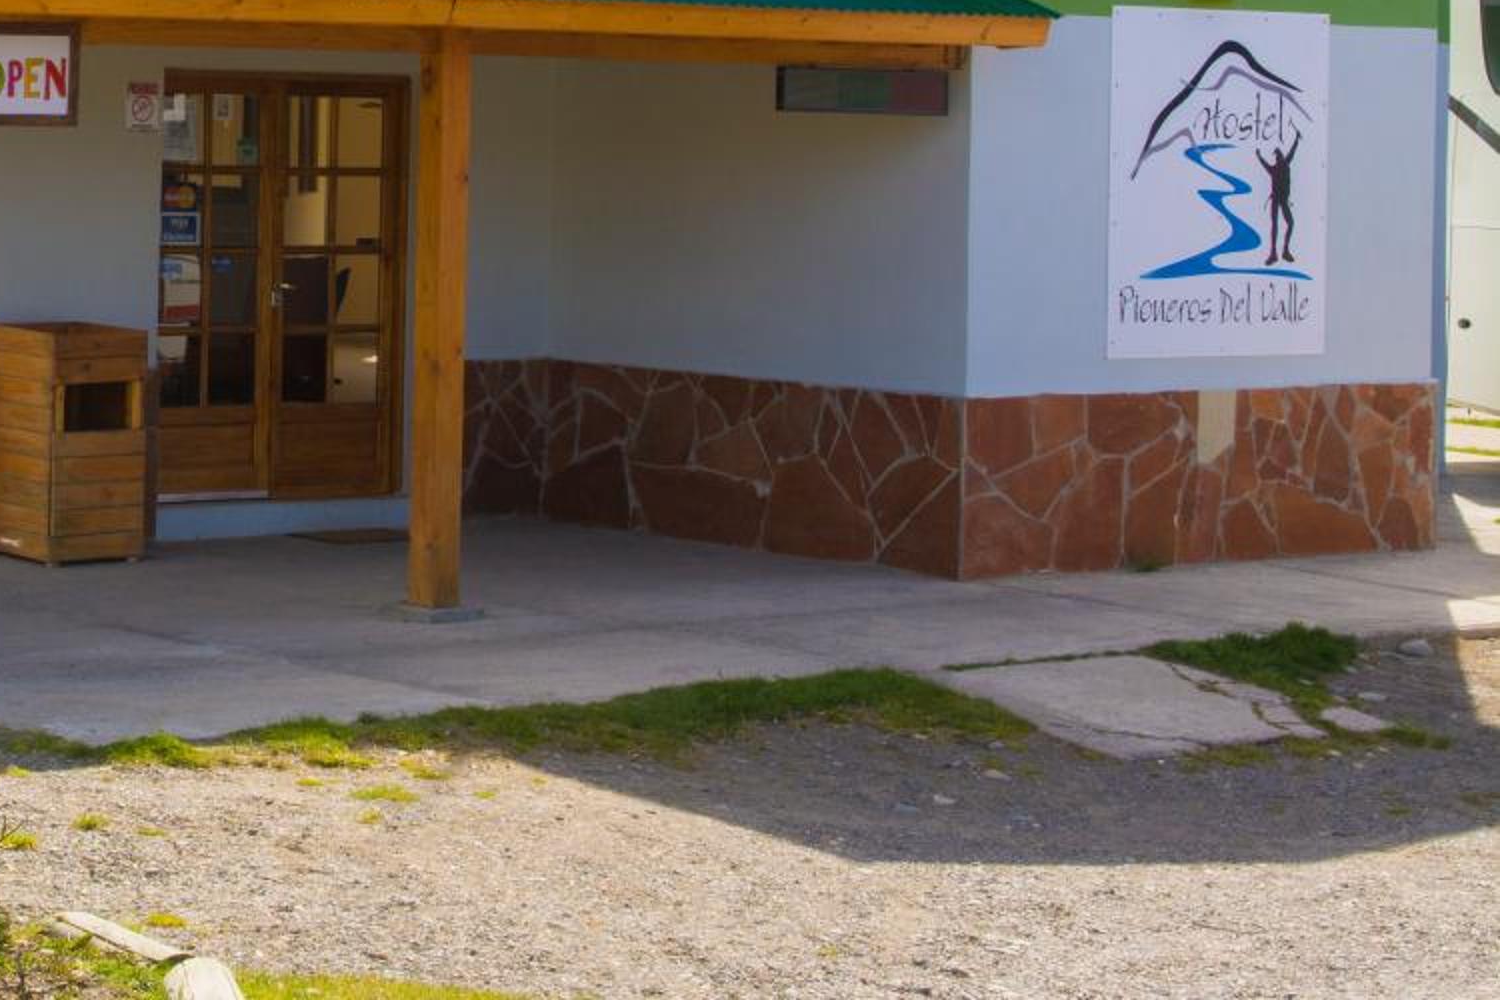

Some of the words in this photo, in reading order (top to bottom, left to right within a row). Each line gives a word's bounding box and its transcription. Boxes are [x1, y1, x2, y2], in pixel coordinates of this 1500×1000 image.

[1193, 92, 1284, 145] Hostel
[1118, 285, 1212, 324] Pioneros
[1219, 282, 1251, 324] Del
[1261, 281, 1310, 324] Valle
